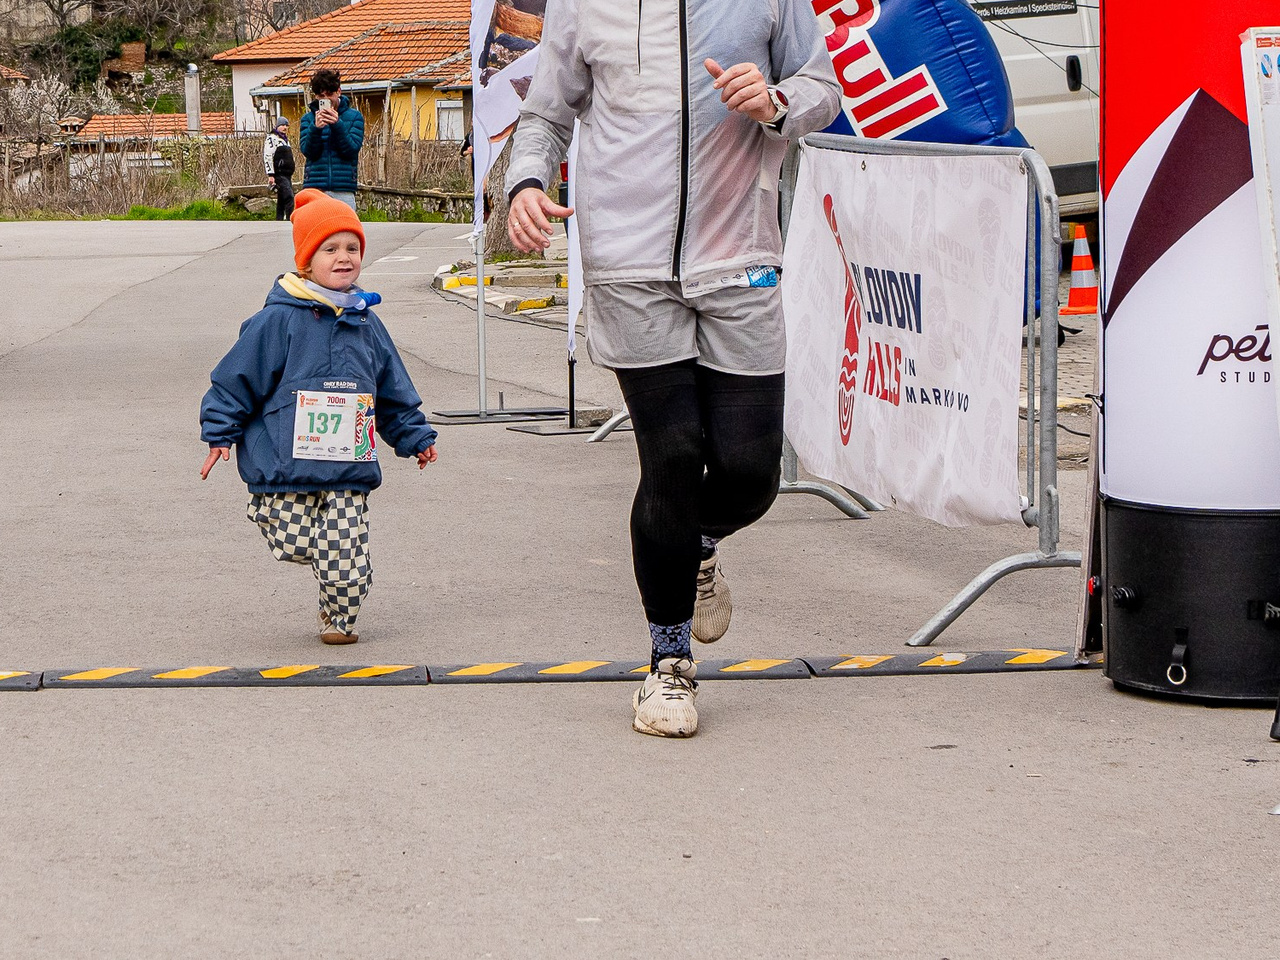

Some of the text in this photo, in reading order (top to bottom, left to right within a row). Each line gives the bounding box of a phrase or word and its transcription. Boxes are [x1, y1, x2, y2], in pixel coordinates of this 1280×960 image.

[904, 357, 917, 376] IN
[1220, 371, 1271, 383] STUD
[326, 396, 346, 404] 700m
[905, 386, 969, 412] MARKOVO
[307, 411, 342, 435] 137
